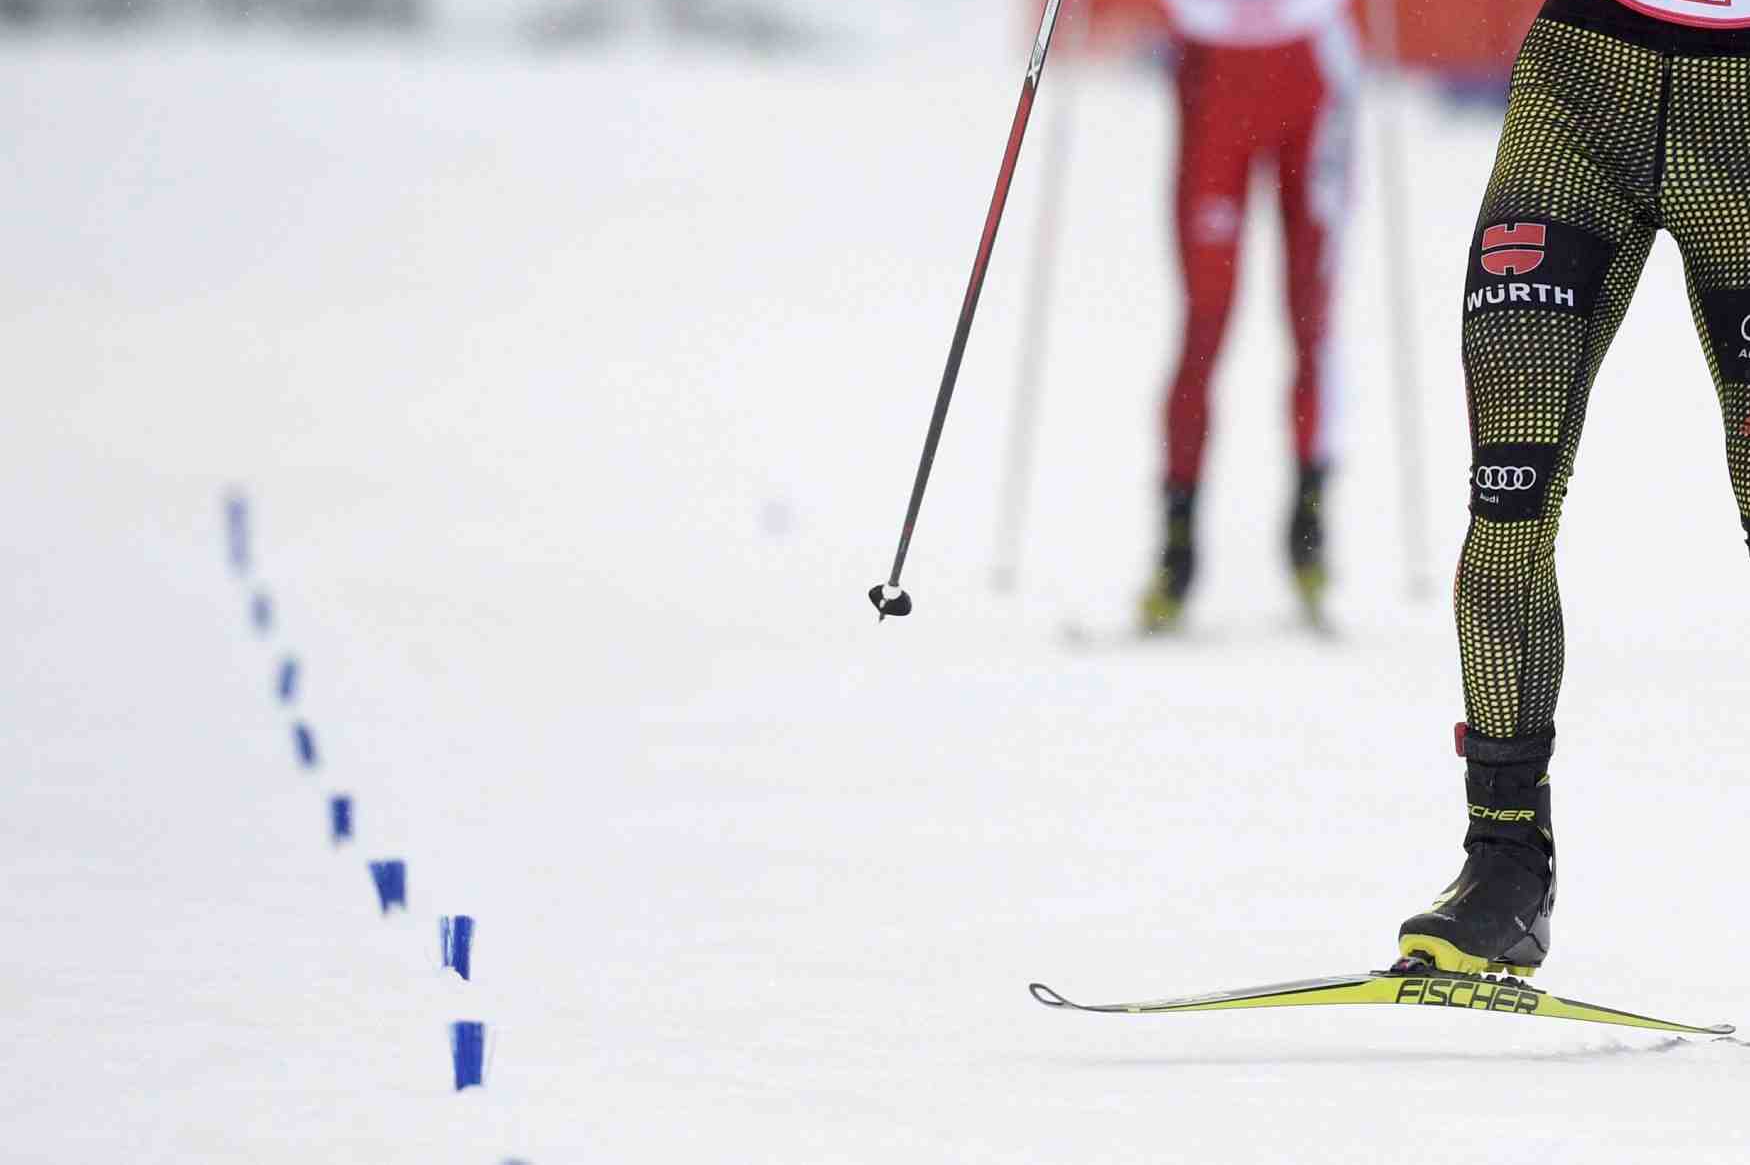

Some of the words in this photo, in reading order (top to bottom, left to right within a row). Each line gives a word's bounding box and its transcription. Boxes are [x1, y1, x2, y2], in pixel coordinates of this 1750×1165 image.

[1467, 283, 1574, 312] WÜRTH
[1467, 802, 1535, 822] CHER
[1395, 978, 1540, 1014] FISCHER
